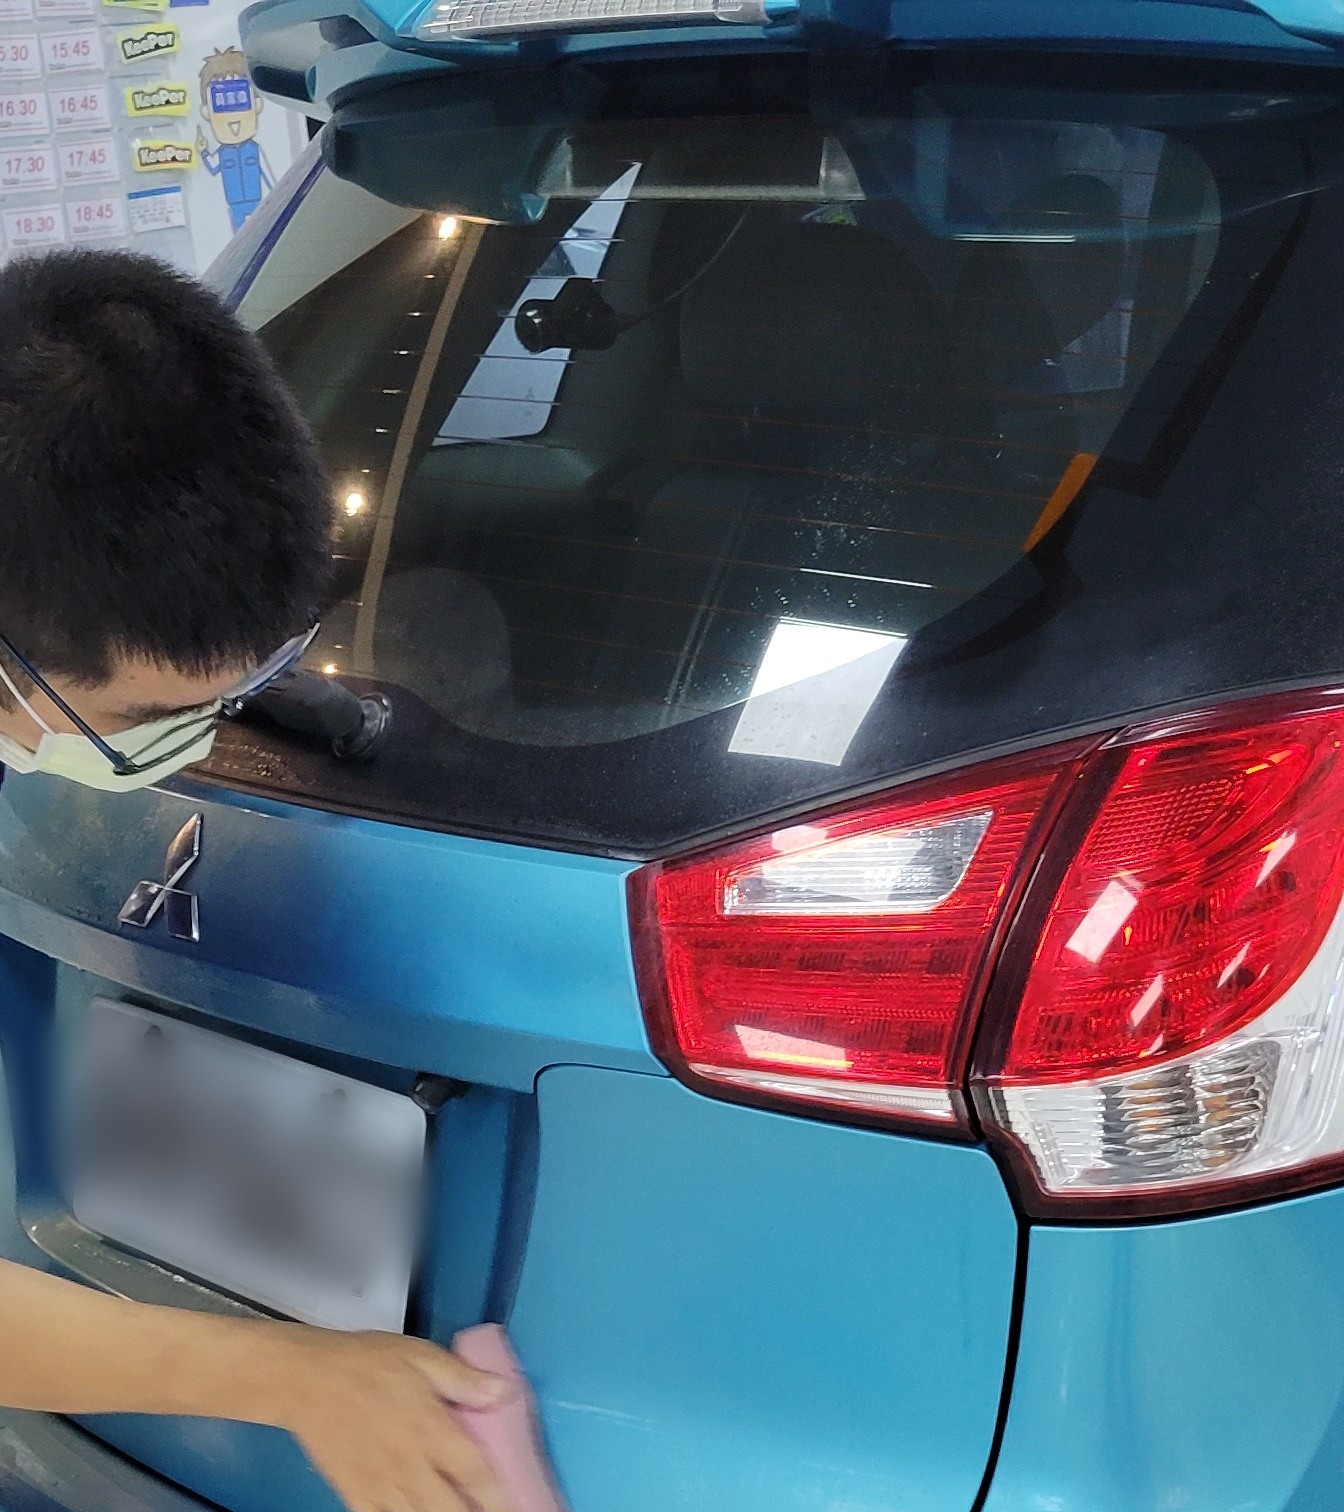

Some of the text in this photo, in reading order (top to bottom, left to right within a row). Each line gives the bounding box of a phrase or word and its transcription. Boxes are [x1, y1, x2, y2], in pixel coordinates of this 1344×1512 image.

[51, 40, 90, 59] 15:45
[59, 95, 98, 113] 16:45
[6, 156, 45, 174] 17:30
[68, 148, 106, 167] 17:45
[76, 204, 114, 222] 18:45
[16, 216, 55, 234] 18:30
